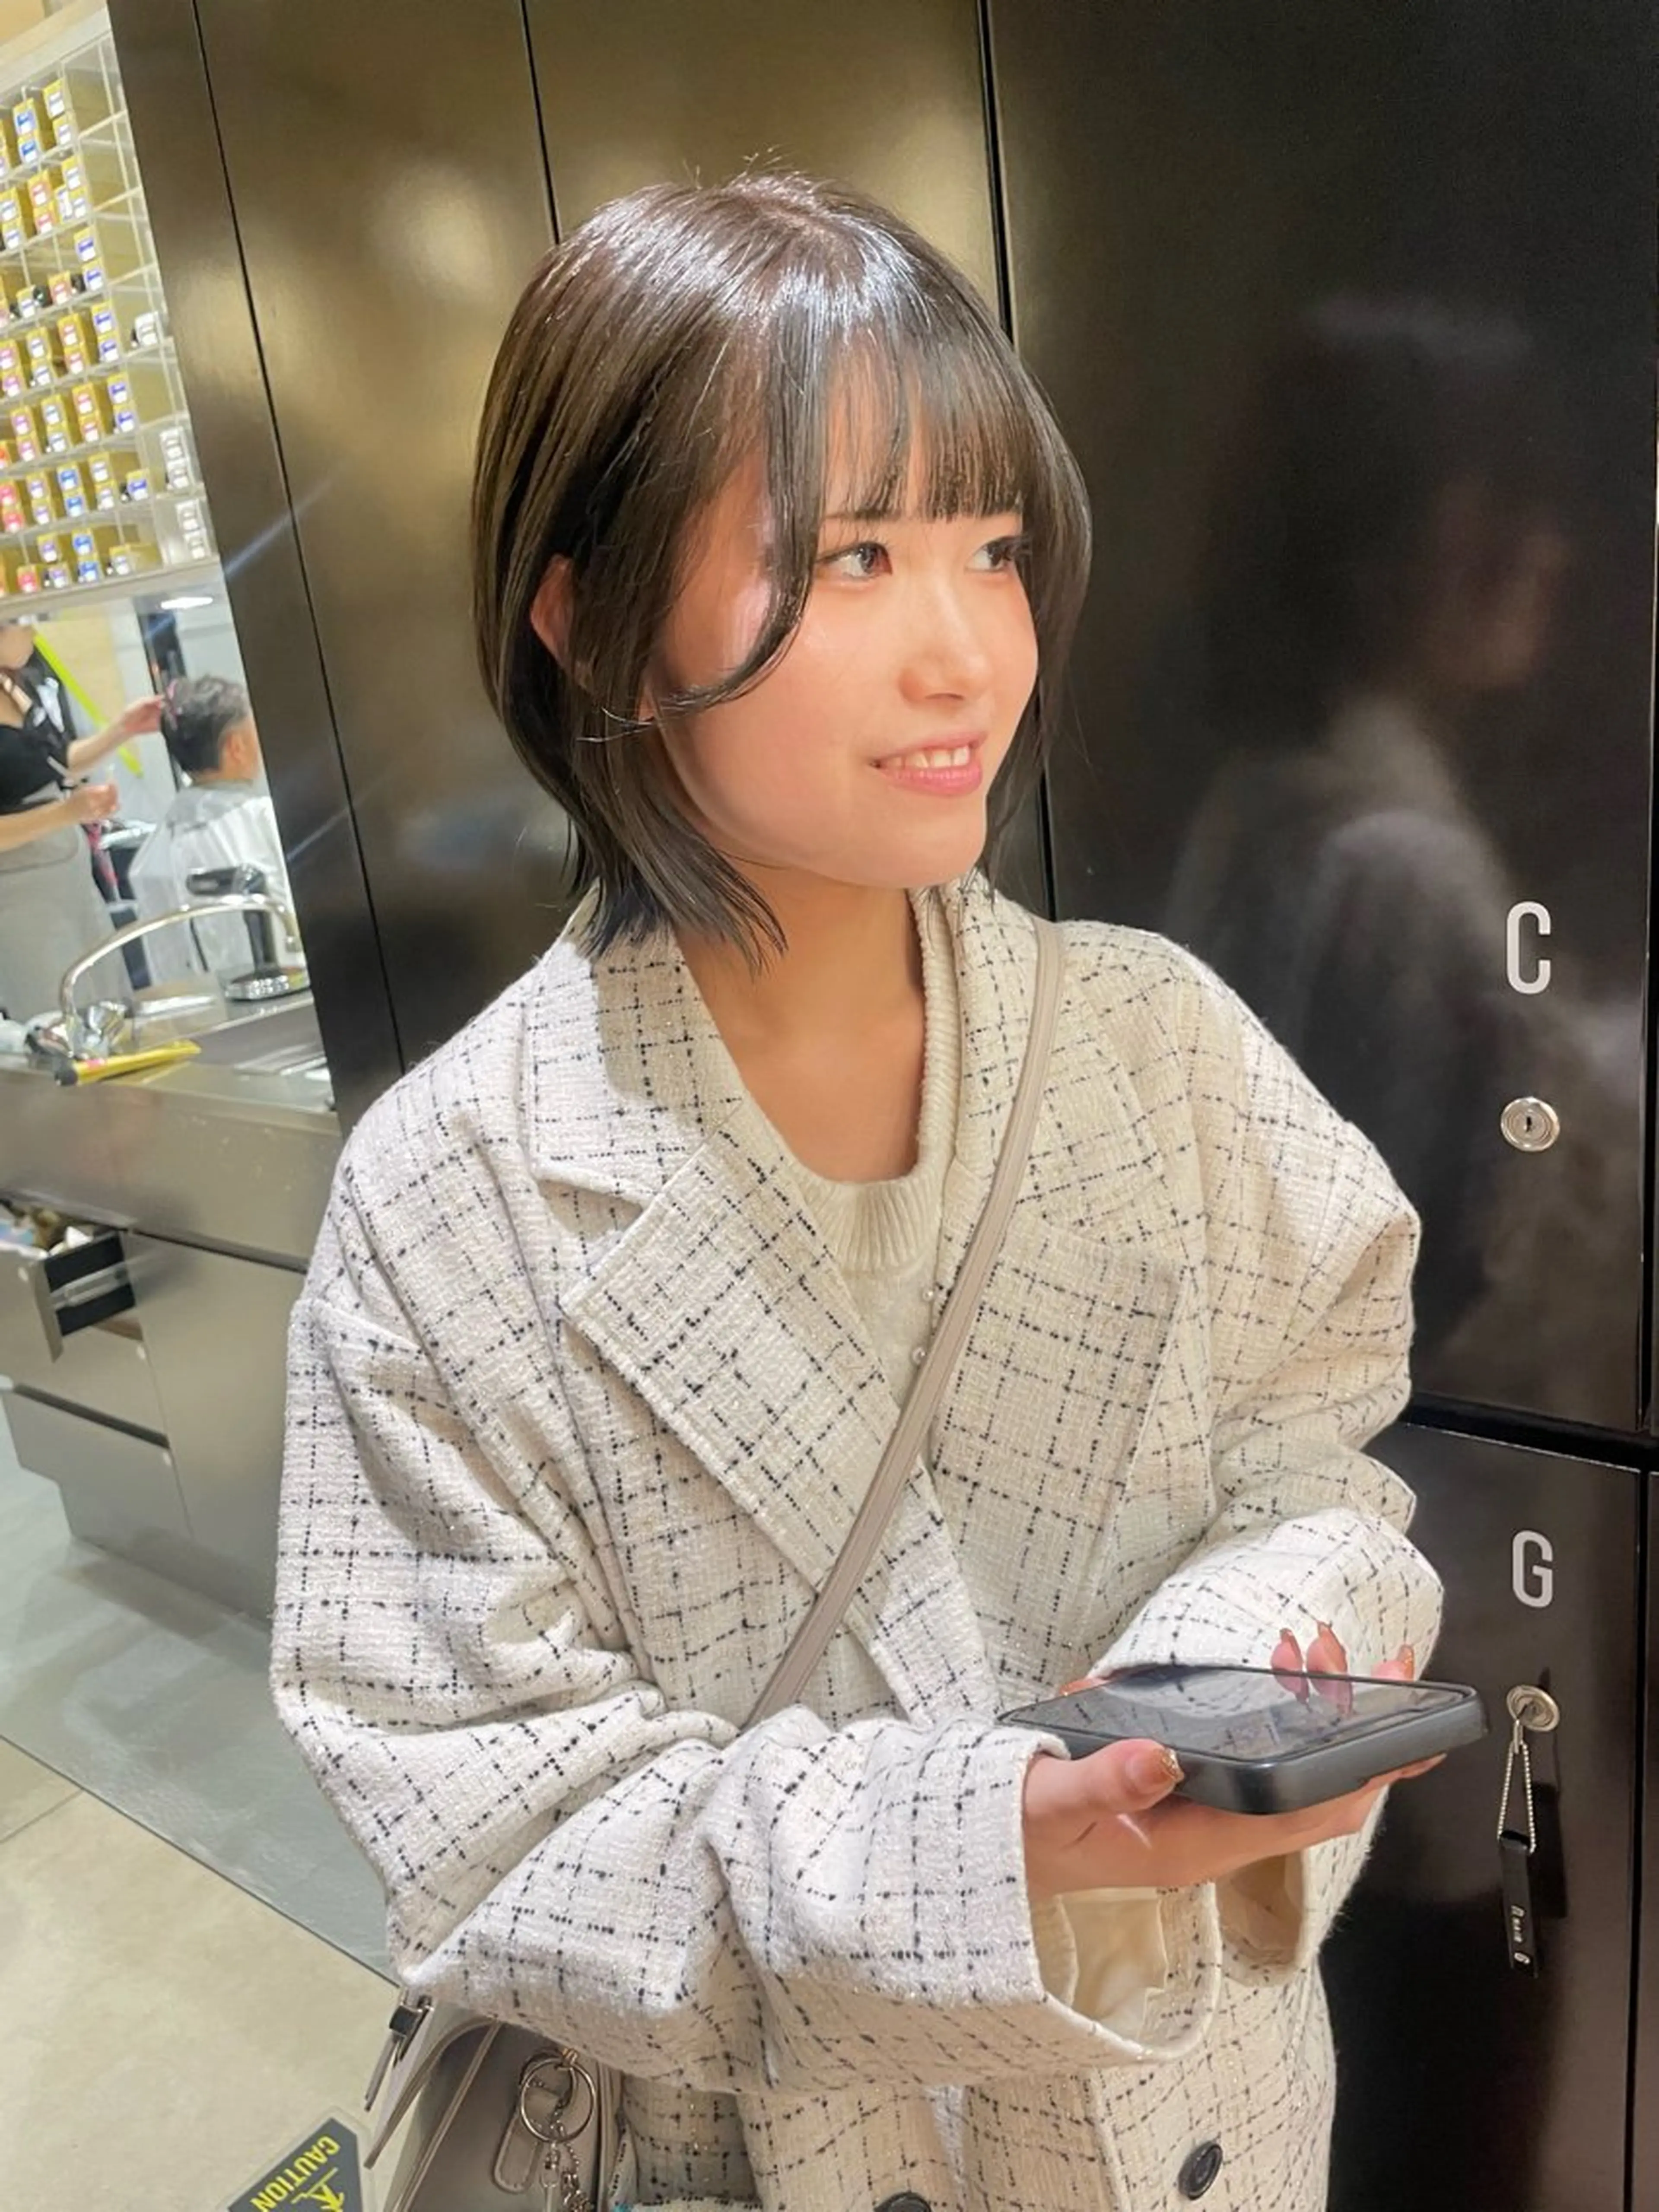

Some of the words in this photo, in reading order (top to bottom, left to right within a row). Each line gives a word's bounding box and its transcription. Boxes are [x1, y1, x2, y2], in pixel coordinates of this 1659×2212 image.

[1506, 901, 1551, 994] C
[1512, 1529, 1554, 1608] G
[249, 2136, 341, 2212] CAUTION
